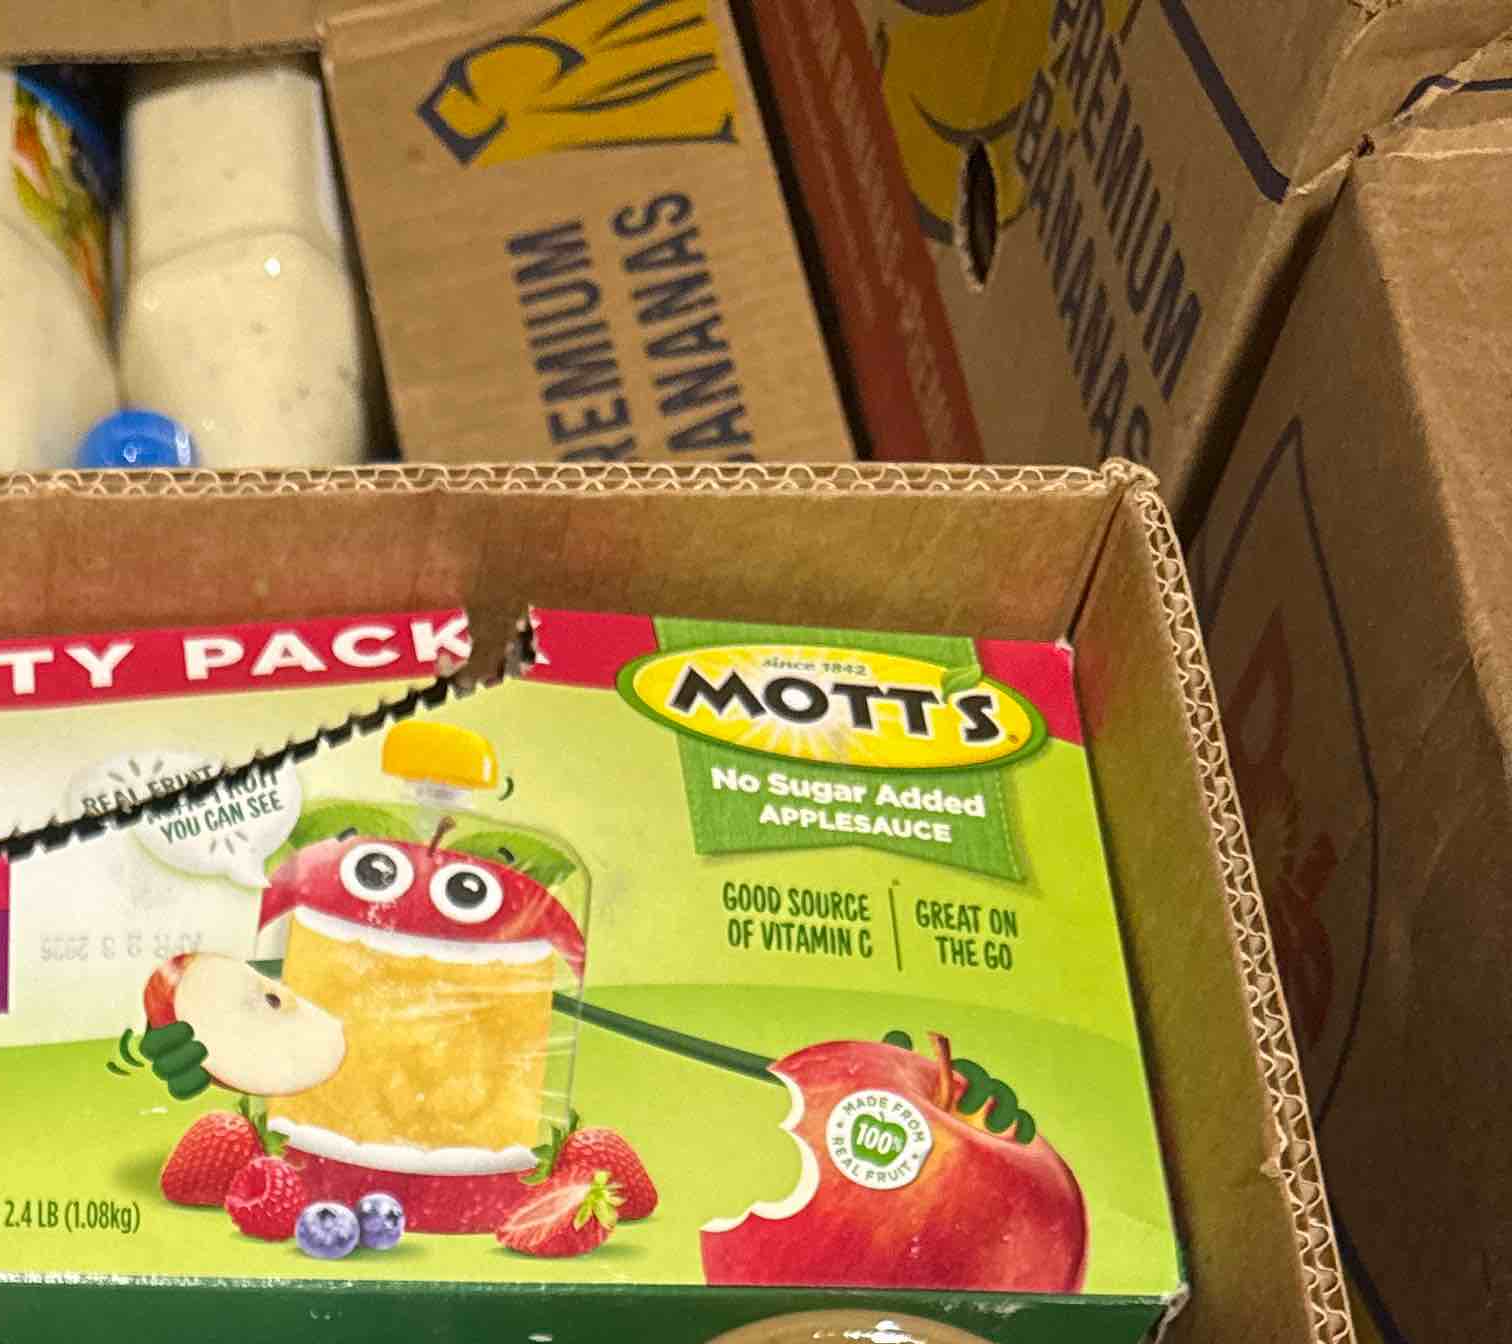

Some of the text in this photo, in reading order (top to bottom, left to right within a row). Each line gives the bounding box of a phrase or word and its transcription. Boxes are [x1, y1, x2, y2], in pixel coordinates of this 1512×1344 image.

[505, 216, 637, 464] REMIUM
[609, 192, 756, 464] ANANAS
[182, 618, 476, 681] PACK
[762, 656, 868, 678] since 1842
[668, 665, 1002, 743] MOTT'S
[711, 767, 986, 818] No Sugar Added
[159, 817, 201, 844] YOU
[206, 802, 246, 832] CAN
[248, 790, 286, 819] SEE
[759, 803, 954, 843] APPLESAUCE
[722, 881, 872, 922] GOOD SOURCE
[915, 899, 1019, 938] GREAT ON
[727, 917, 874, 959] OF VITAMIN C
[935, 934, 1014, 972] THE GO
[842, 1095, 925, 1142] MADE FROM
[832, 1137, 912, 1182] REAL FRUIT
[4, 1200, 34, 1229] 2.4
[37, 1200, 60, 1229] LB
[64, 1201, 142, 1235] (1.08kg)
